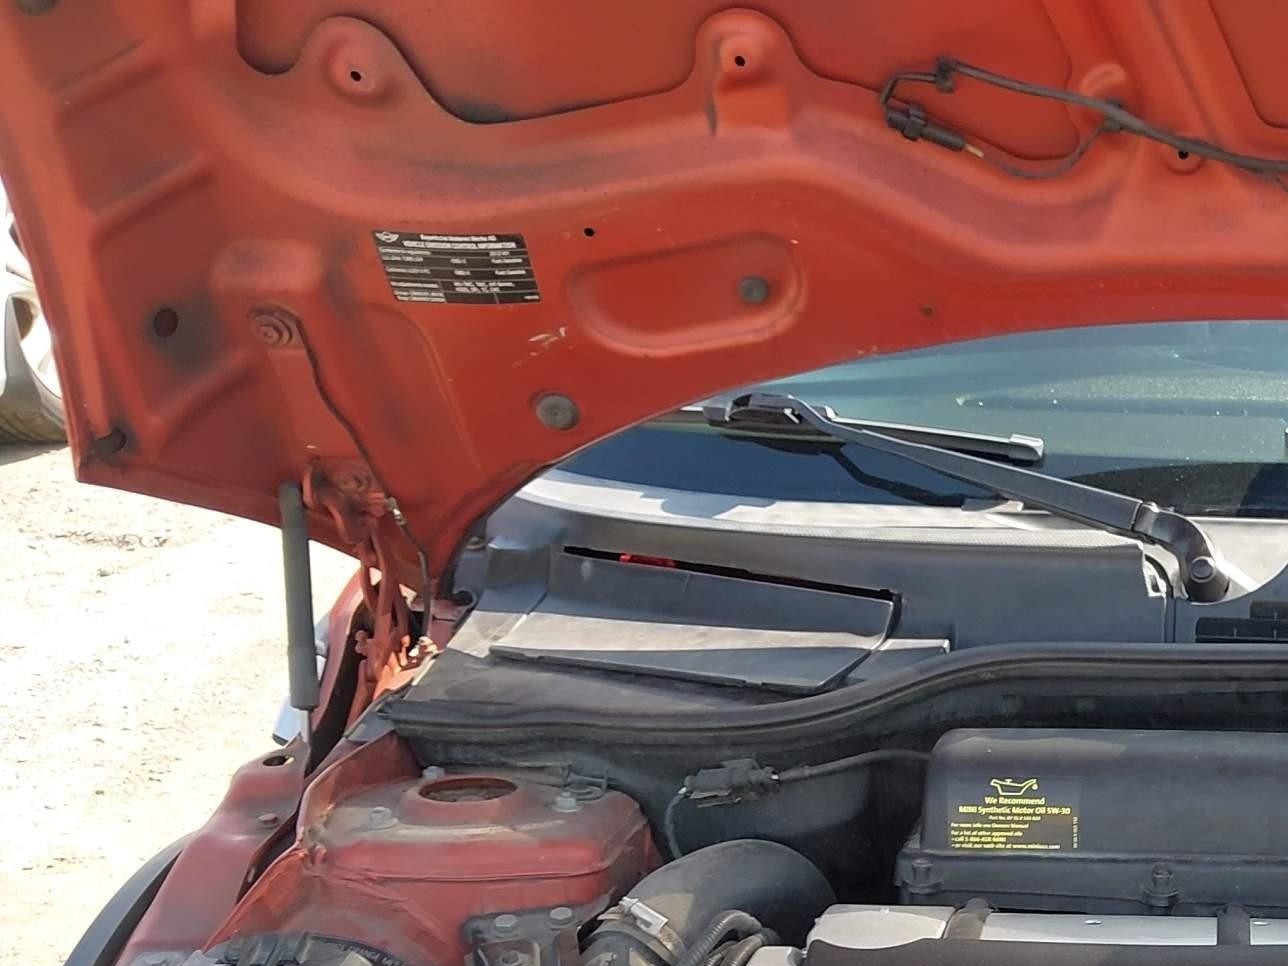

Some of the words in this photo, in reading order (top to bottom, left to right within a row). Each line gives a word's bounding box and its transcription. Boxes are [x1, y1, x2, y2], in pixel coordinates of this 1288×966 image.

[985, 797, 998, 805] We
[999, 797, 1045, 805] Recommend
[959, 806, 977, 814] MINI
[978, 806, 1011, 816] Synthetic
[1012, 806, 1034, 815] Motor
[1035, 806, 1046, 815] Oil
[1047, 807, 1071, 815] 5W-30
